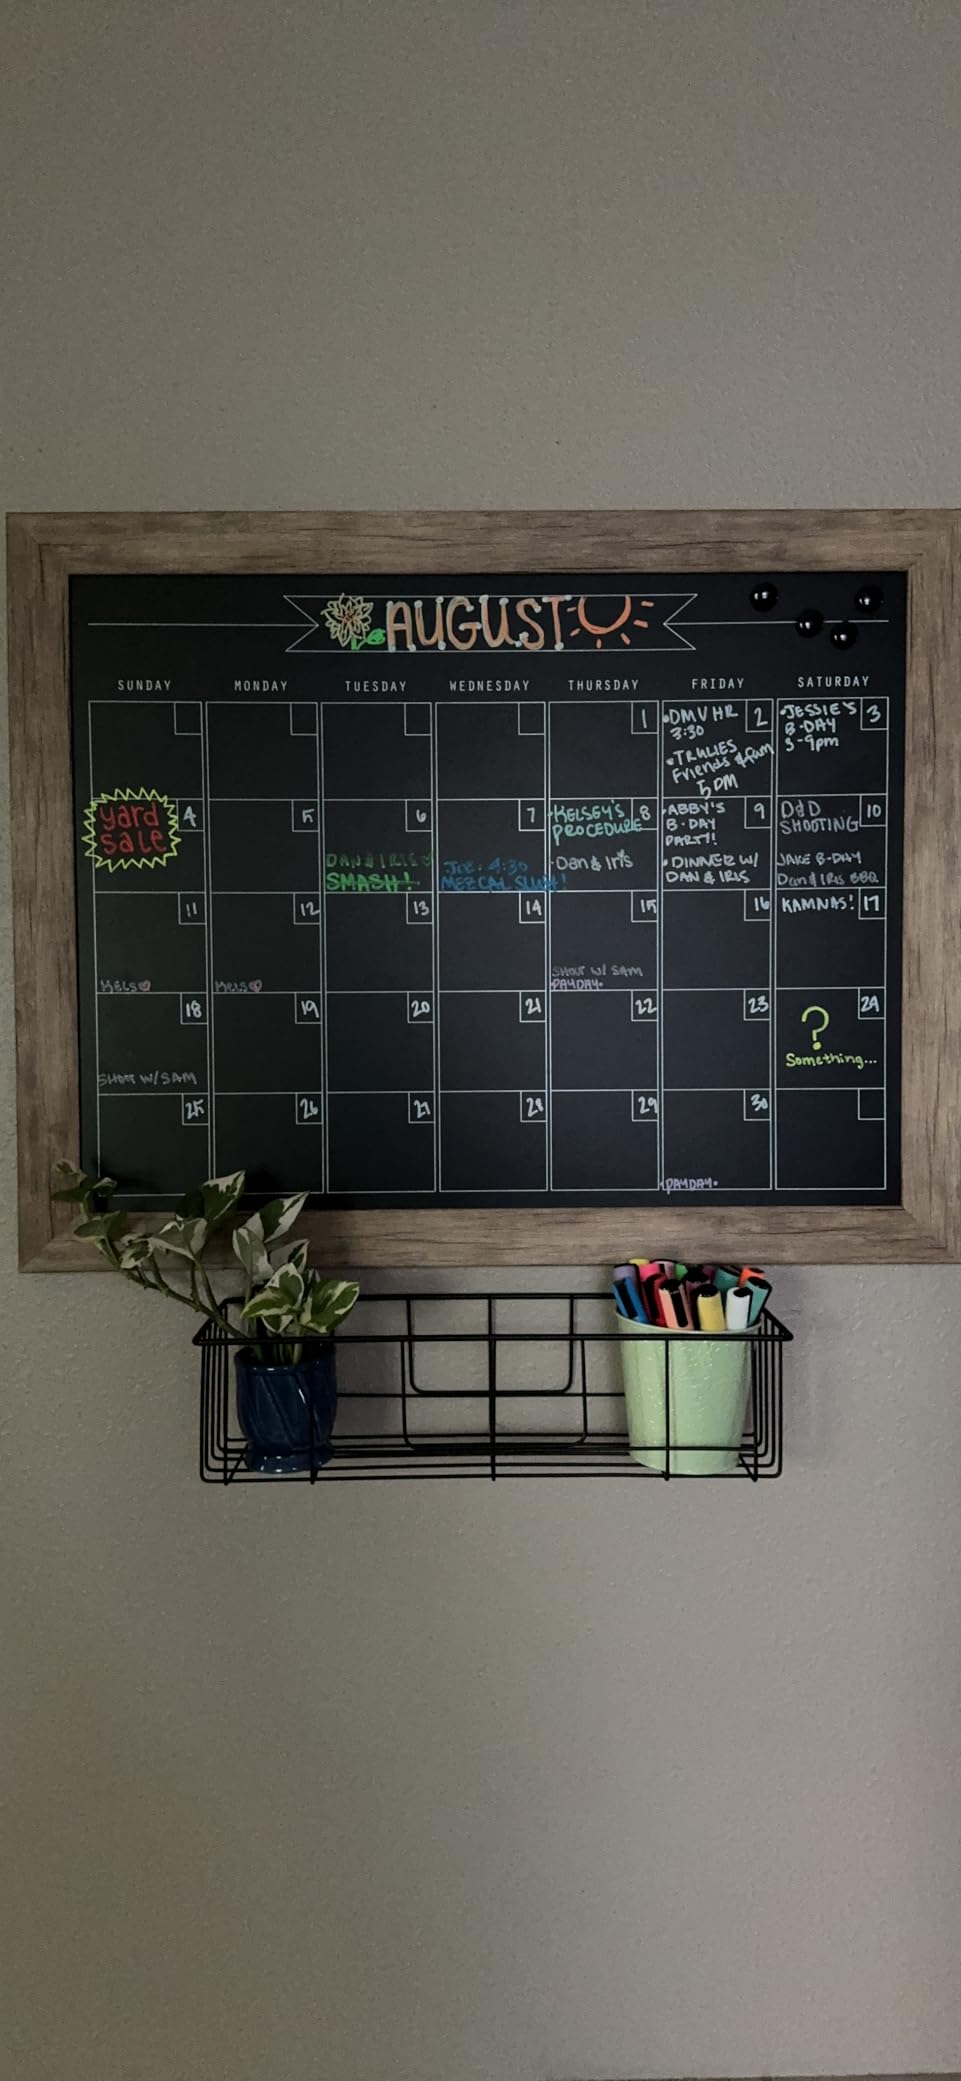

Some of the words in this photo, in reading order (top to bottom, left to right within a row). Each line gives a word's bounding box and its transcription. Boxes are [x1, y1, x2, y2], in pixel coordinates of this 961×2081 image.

[386, 594, 573, 652] AUGUST
[117, 679, 172, 691] SUNDAY
[233, 680, 288, 692] MONDAY
[344, 680, 407, 692] TUESDAY
[449, 680, 530, 692] WEDNESDAY
[567, 679, 640, 691] THURSDAY
[691, 678, 745, 690] FRIDAY
[797, 675, 870, 688] SATURDAY
[640, 708, 647, 729] 1
[669, 704, 708, 725] DMV
[712, 704, 739, 722] HR
[754, 706, 769, 727] 2
[866, 704, 881, 723] 3
[669, 724, 705, 741] 3:30
[99, 801, 160, 831] yard
[183, 805, 198, 828] 4
[416, 809, 427, 823] 6
[526, 808, 537, 823] 7
[639, 805, 652, 821] 8
[753, 802, 768, 820] 9
[866, 803, 882, 819] 10
[779, 816, 860, 835] SHOOTING
[99, 830, 167, 855] sale
[671, 853, 736, 869] DINNER
[665, 871, 701, 883] DAN
[186, 903, 197, 917] 11
[300, 901, 320, 917] 12
[413, 900, 430, 916] 13
[526, 899, 542, 916] 14
[640, 899, 657, 914] 15
[754, 898, 770, 911] 16
[863, 894, 880, 912] 17
[185, 1002, 202, 1018] 18
[300, 1003, 319, 1018] 19
[411, 1001, 431, 1015] 20
[525, 998, 542, 1015] 21
[635, 998, 657, 1014] 22
[748, 997, 769, 1013] 23
[300, 1100, 319, 1117] 26
[638, 1098, 659, 1114] 29
[751, 1094, 769, 1111] 30
